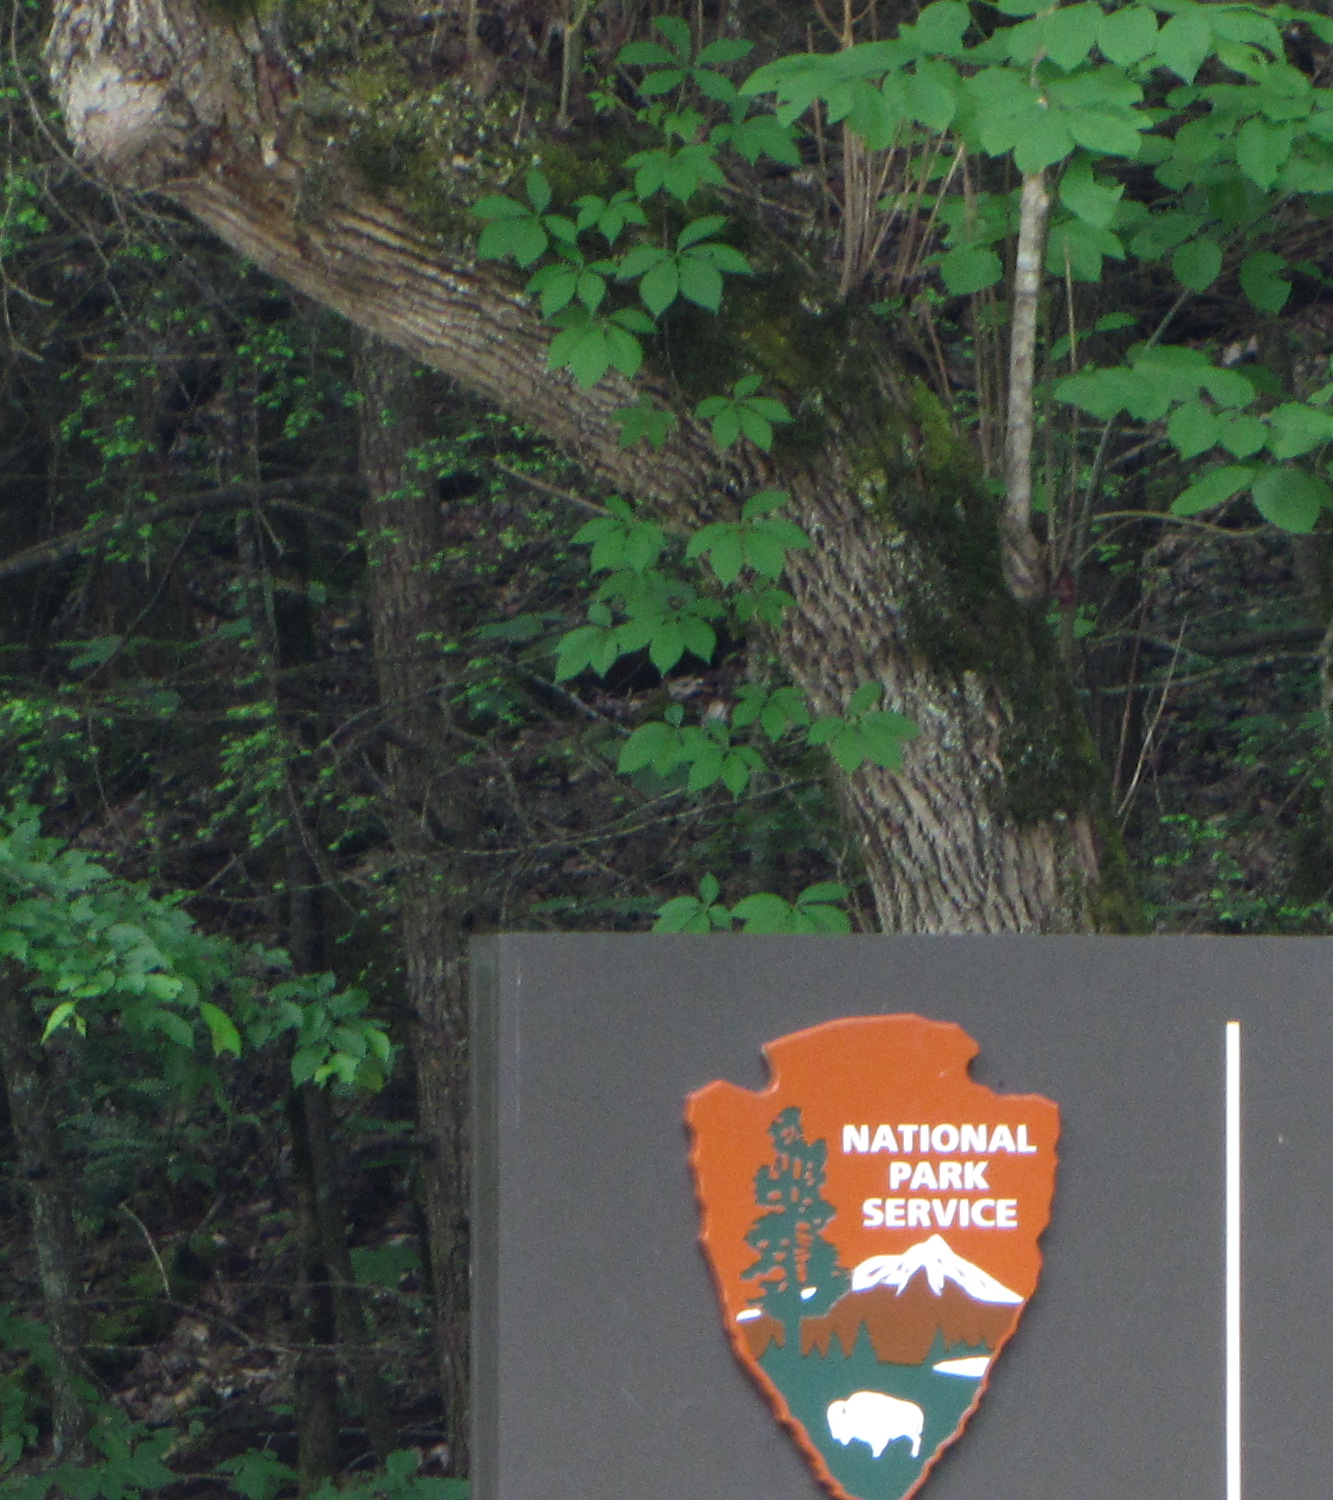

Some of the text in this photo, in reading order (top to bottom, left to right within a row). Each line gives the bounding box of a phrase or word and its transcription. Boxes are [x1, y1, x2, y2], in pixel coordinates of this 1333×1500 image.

[842, 1124, 1038, 1155] NATIONAL
[889, 1161, 990, 1191] PARK
[862, 1199, 1018, 1228] SERVICE
